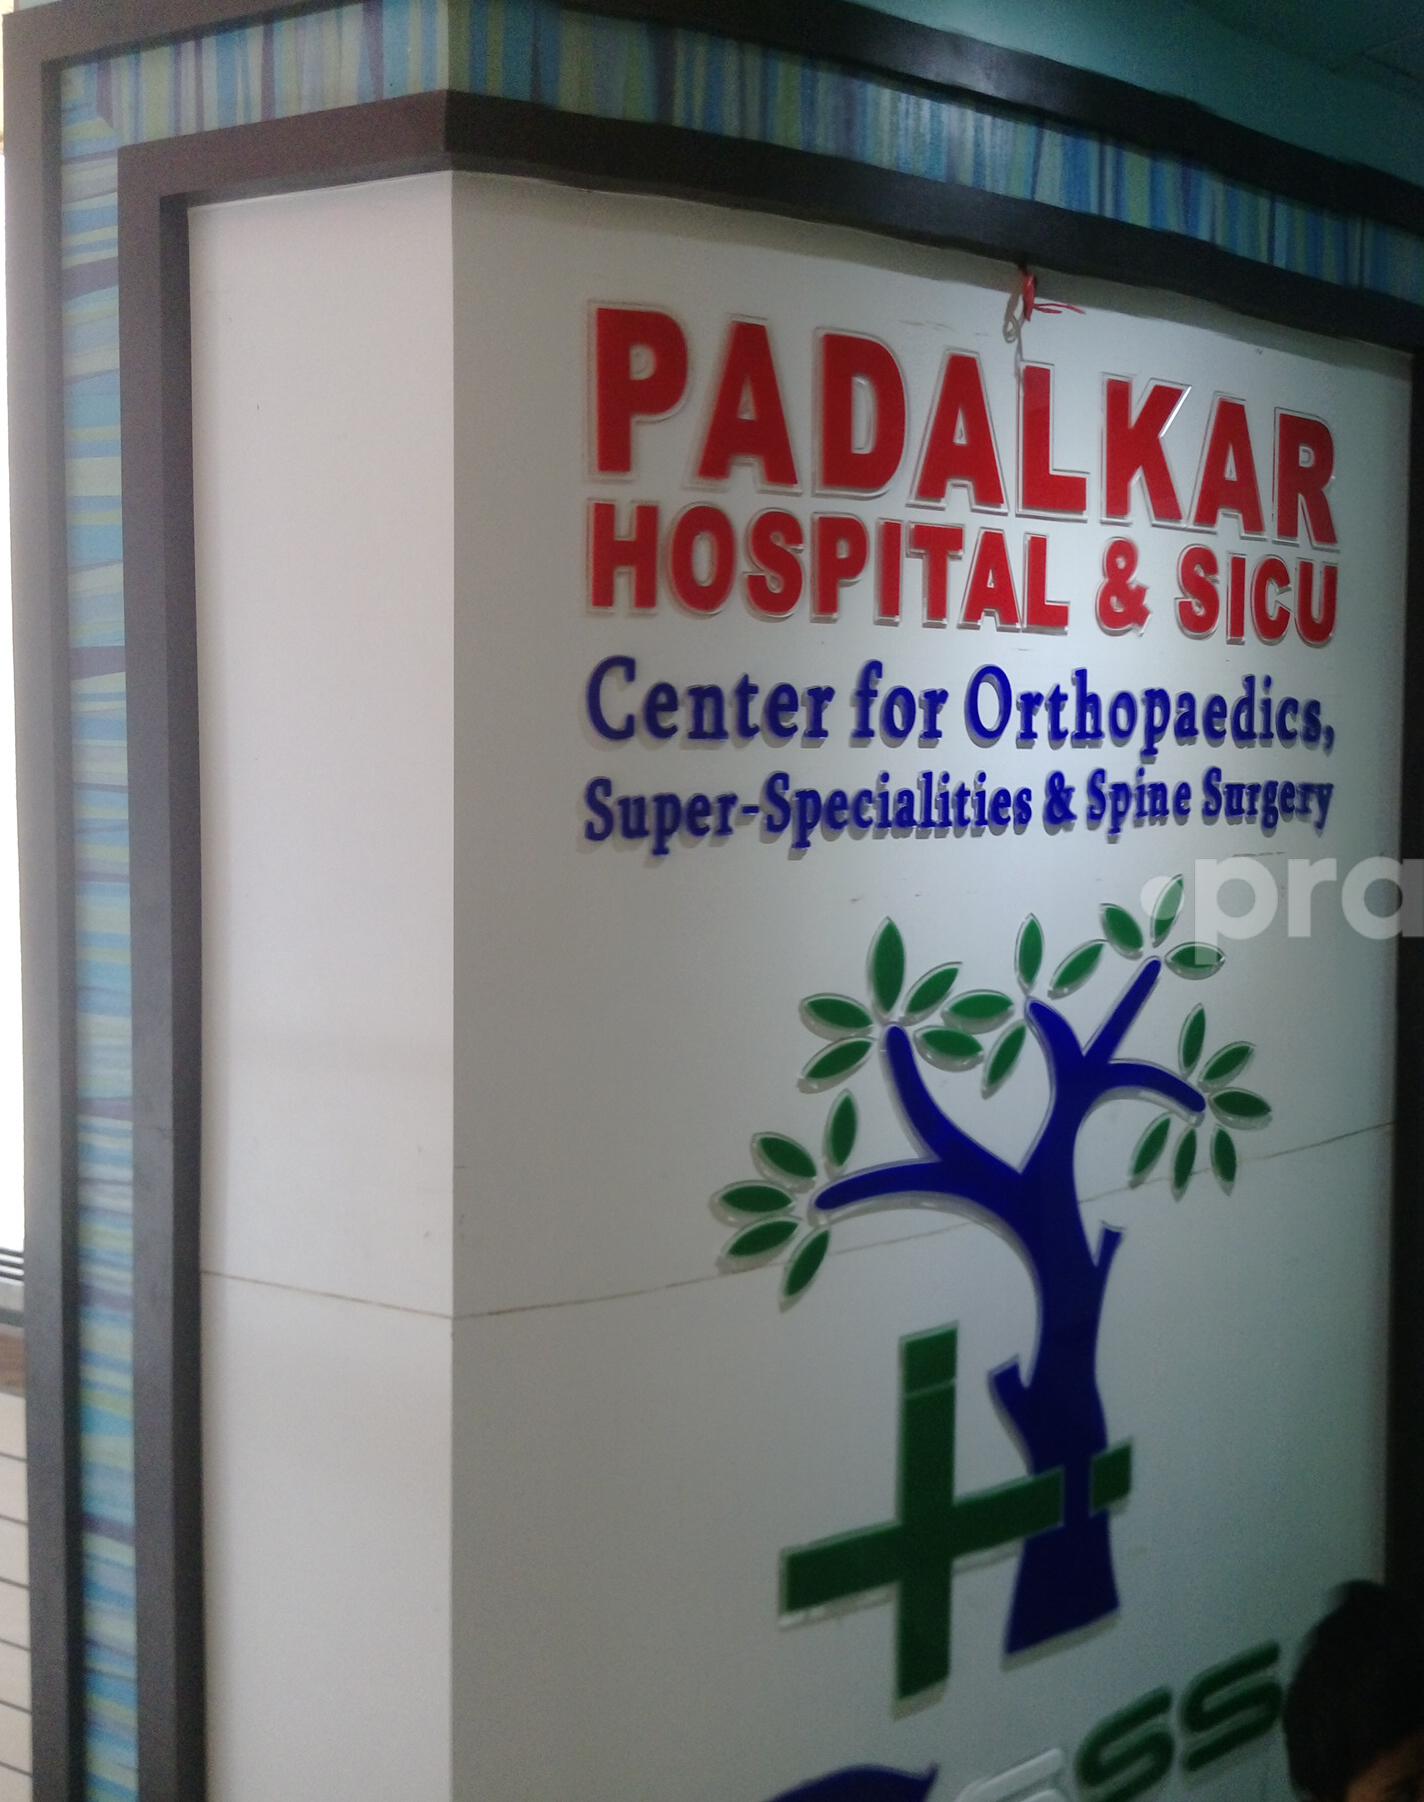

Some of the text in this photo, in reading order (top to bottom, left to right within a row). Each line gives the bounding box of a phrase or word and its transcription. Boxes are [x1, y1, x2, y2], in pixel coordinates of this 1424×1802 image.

[594, 304, 1340, 545] PADALKAR
[590, 500, 1340, 645] HOSPITAL & SICU
[587, 655, 1336, 760] Center for Orthopaedics,
[583, 767, 1335, 857] Super-Specialities & Spine Surgery
